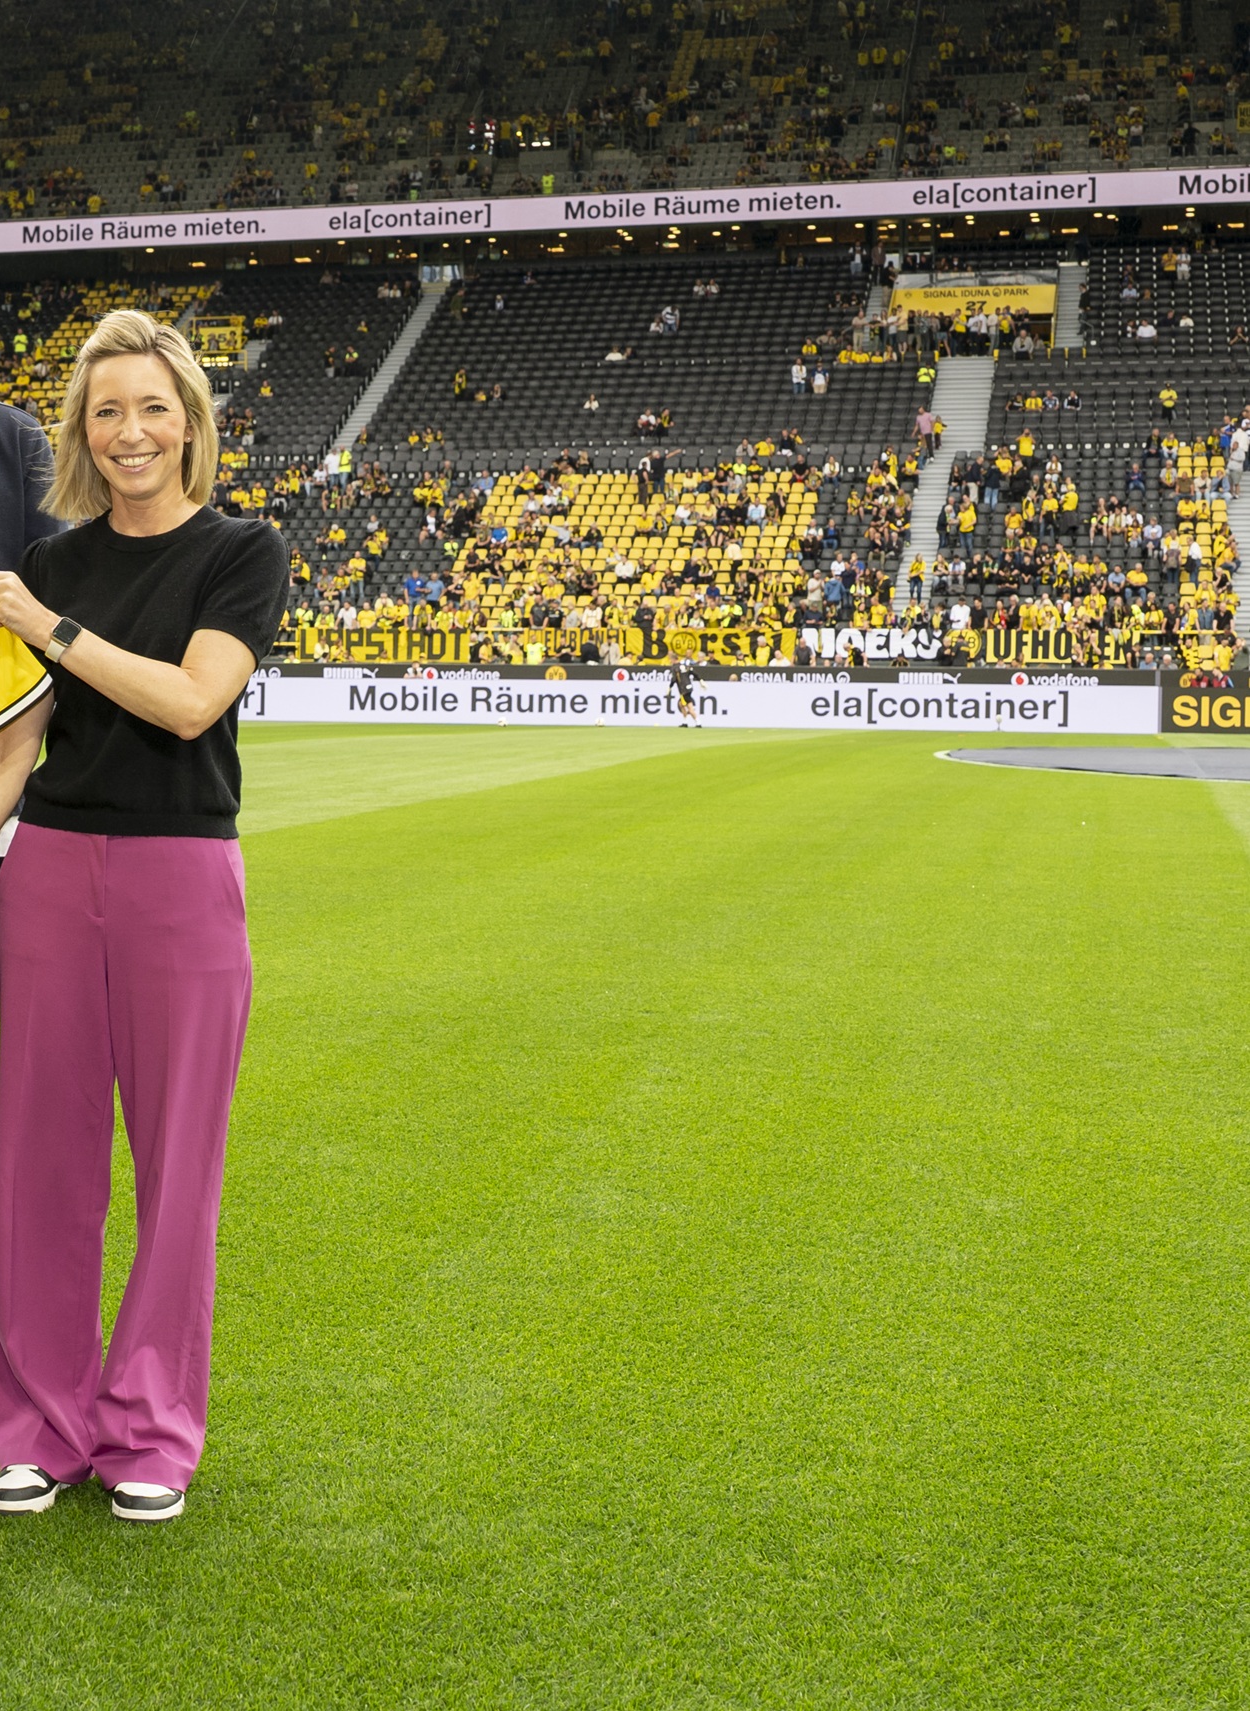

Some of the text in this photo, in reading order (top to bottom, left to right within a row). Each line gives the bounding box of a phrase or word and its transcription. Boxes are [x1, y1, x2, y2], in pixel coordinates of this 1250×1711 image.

[912, 176, 1097, 209] ela[container]
[564, 191, 842, 220] Mobile Räume mieten.
[328, 203, 492, 234] ela[container]
[22, 217, 267, 244] Mobile Räume mieten.
[923, 288, 1029, 299] SIGNAL IDUNA PARK
[966, 300, 988, 311] 27
[440, 667, 501, 680] vodafone
[631, 669, 674, 681] vodaf
[740, 672, 835, 683] SIGNAL IDUNA
[1031, 672, 1099, 686] vodafone
[348, 685, 729, 716] Mobile Räume mietn.
[810, 688, 1069, 727] ela[container]
